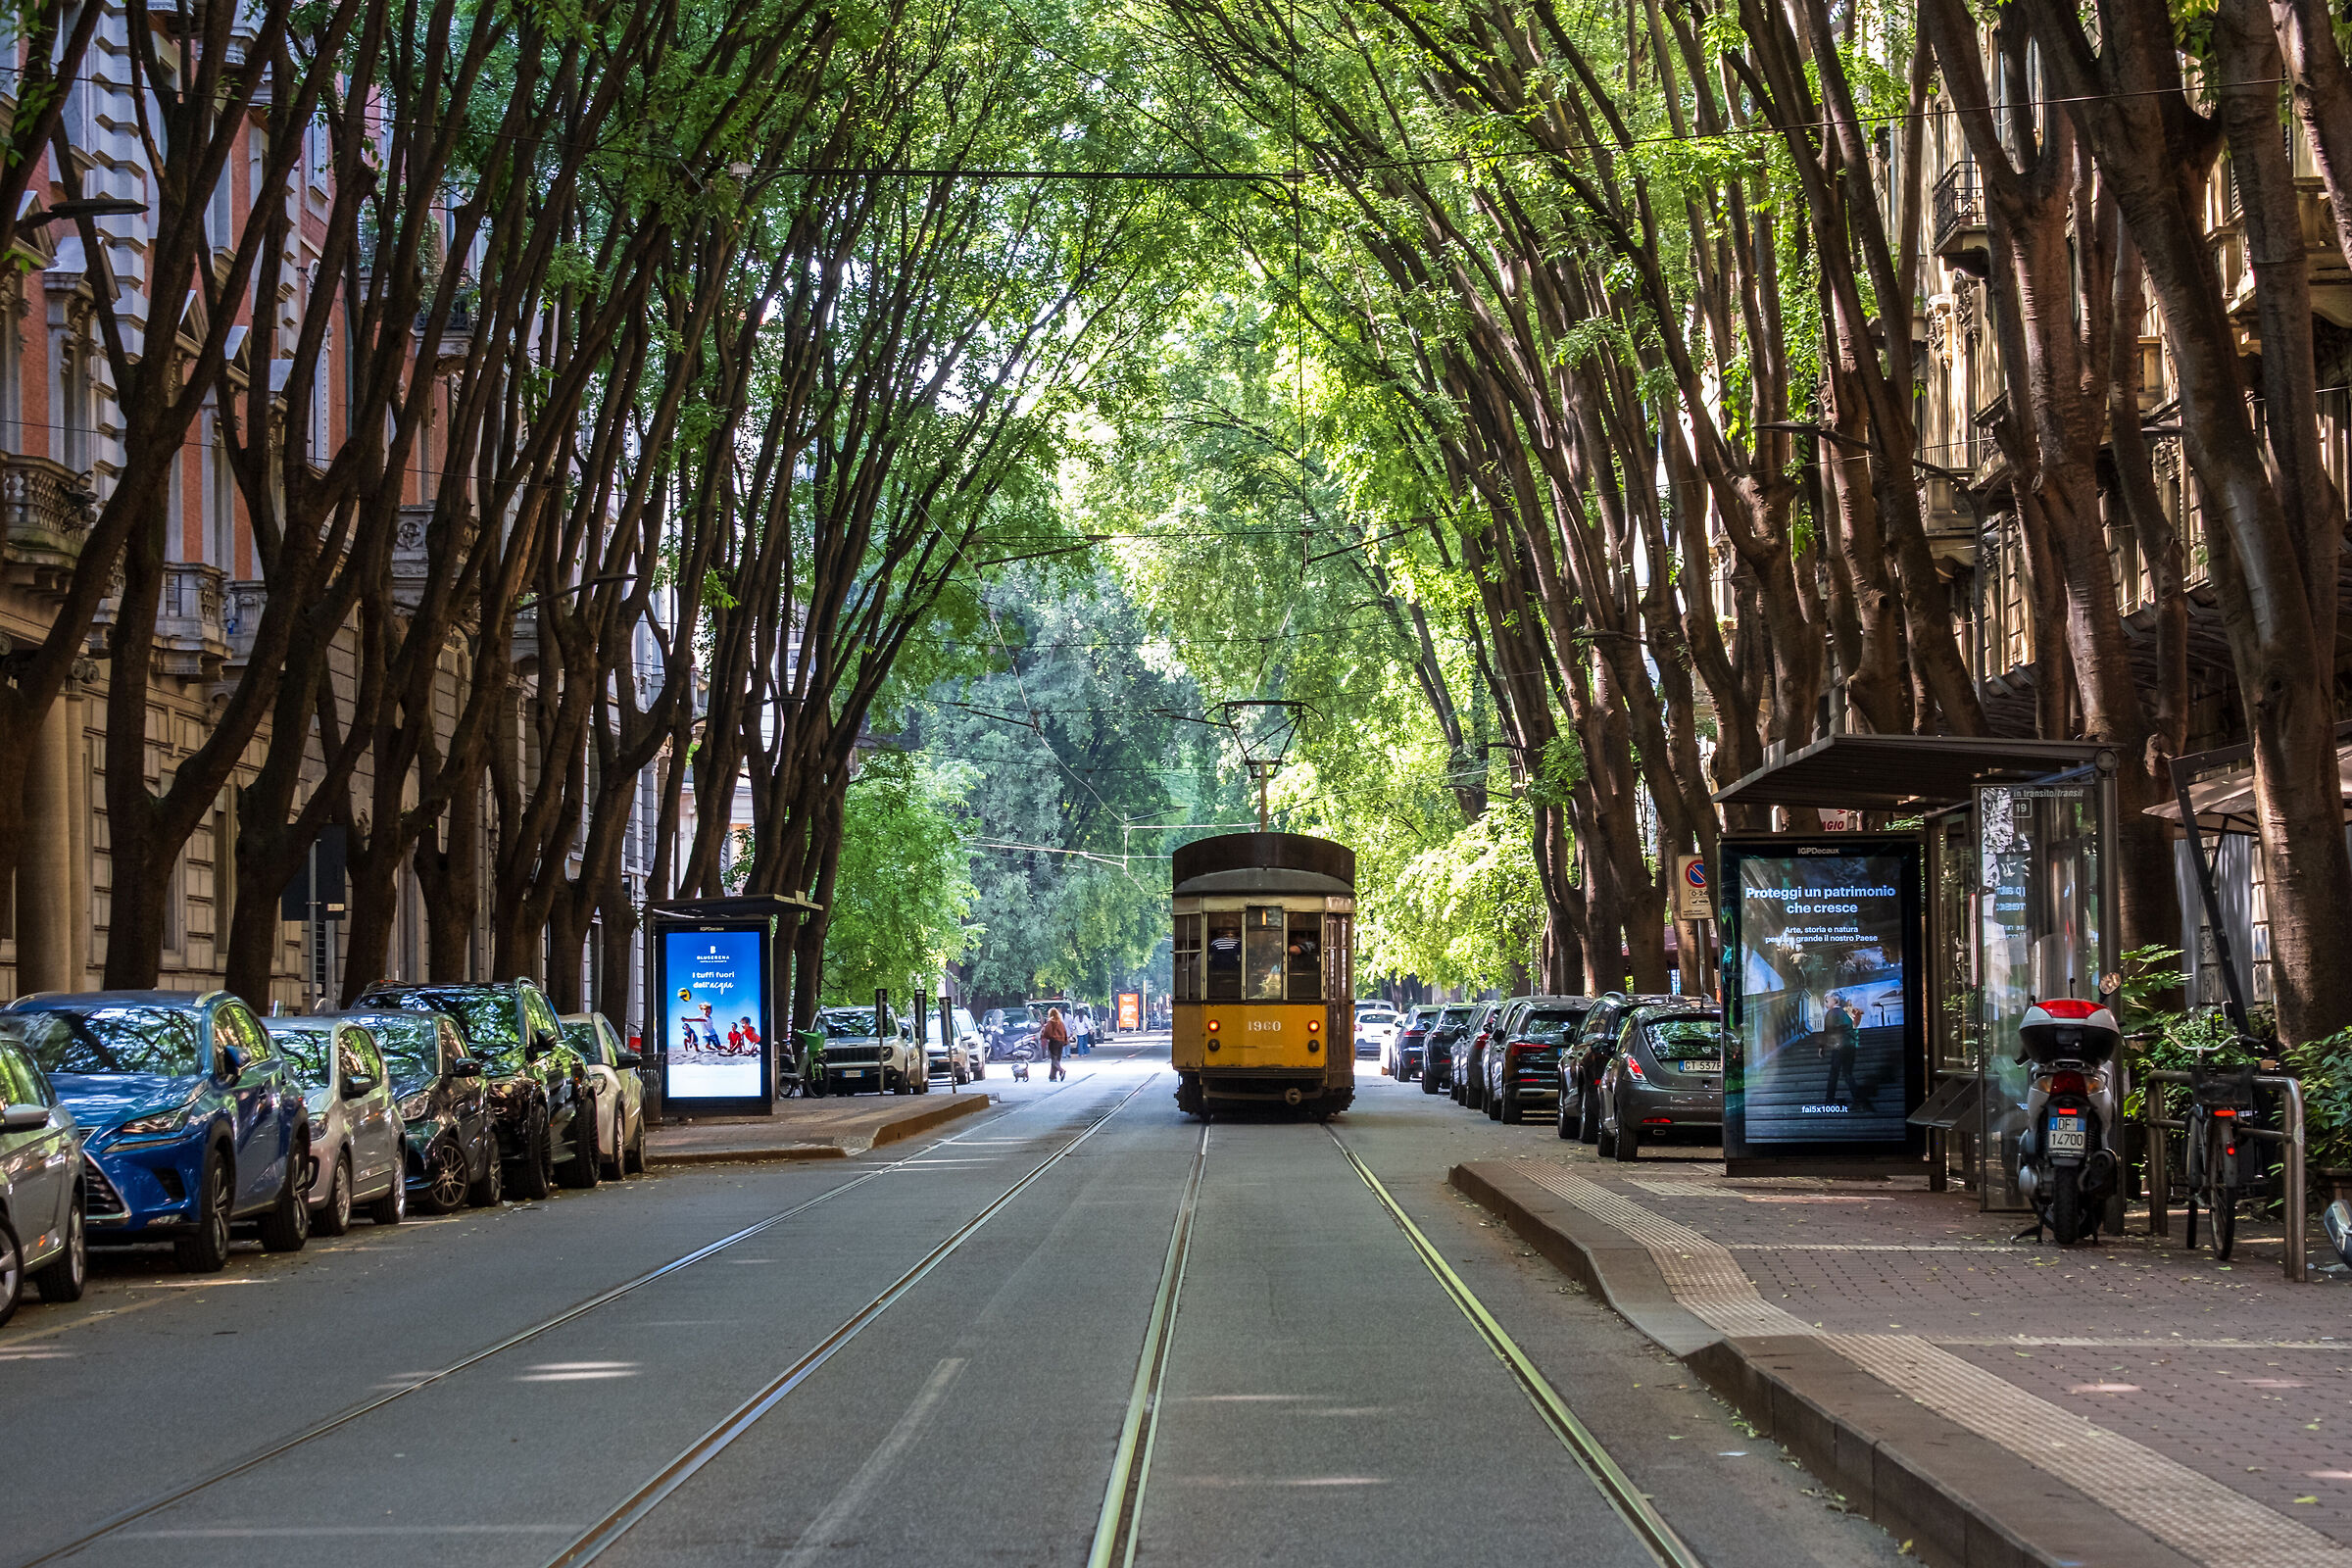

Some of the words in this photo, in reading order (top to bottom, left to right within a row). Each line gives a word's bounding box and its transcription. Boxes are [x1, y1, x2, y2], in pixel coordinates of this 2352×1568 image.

[2015, 804, 2027, 812] 19
[1745, 886, 1802, 900] Proteggi
[1804, 889, 1822, 898] un
[1824, 885, 1896, 899] patrimonio
[1787, 902, 1811, 913] che
[1813, 904, 1858, 913] cresce
[1248, 1020, 1281, 1031] 1960
[1685, 1060, 1696, 1069] GT
[1801, 1104, 1848, 1113] fai5x1000.it
[2059, 1118, 2072, 1130] DF
[2051, 1133, 2083, 1146] 14700
